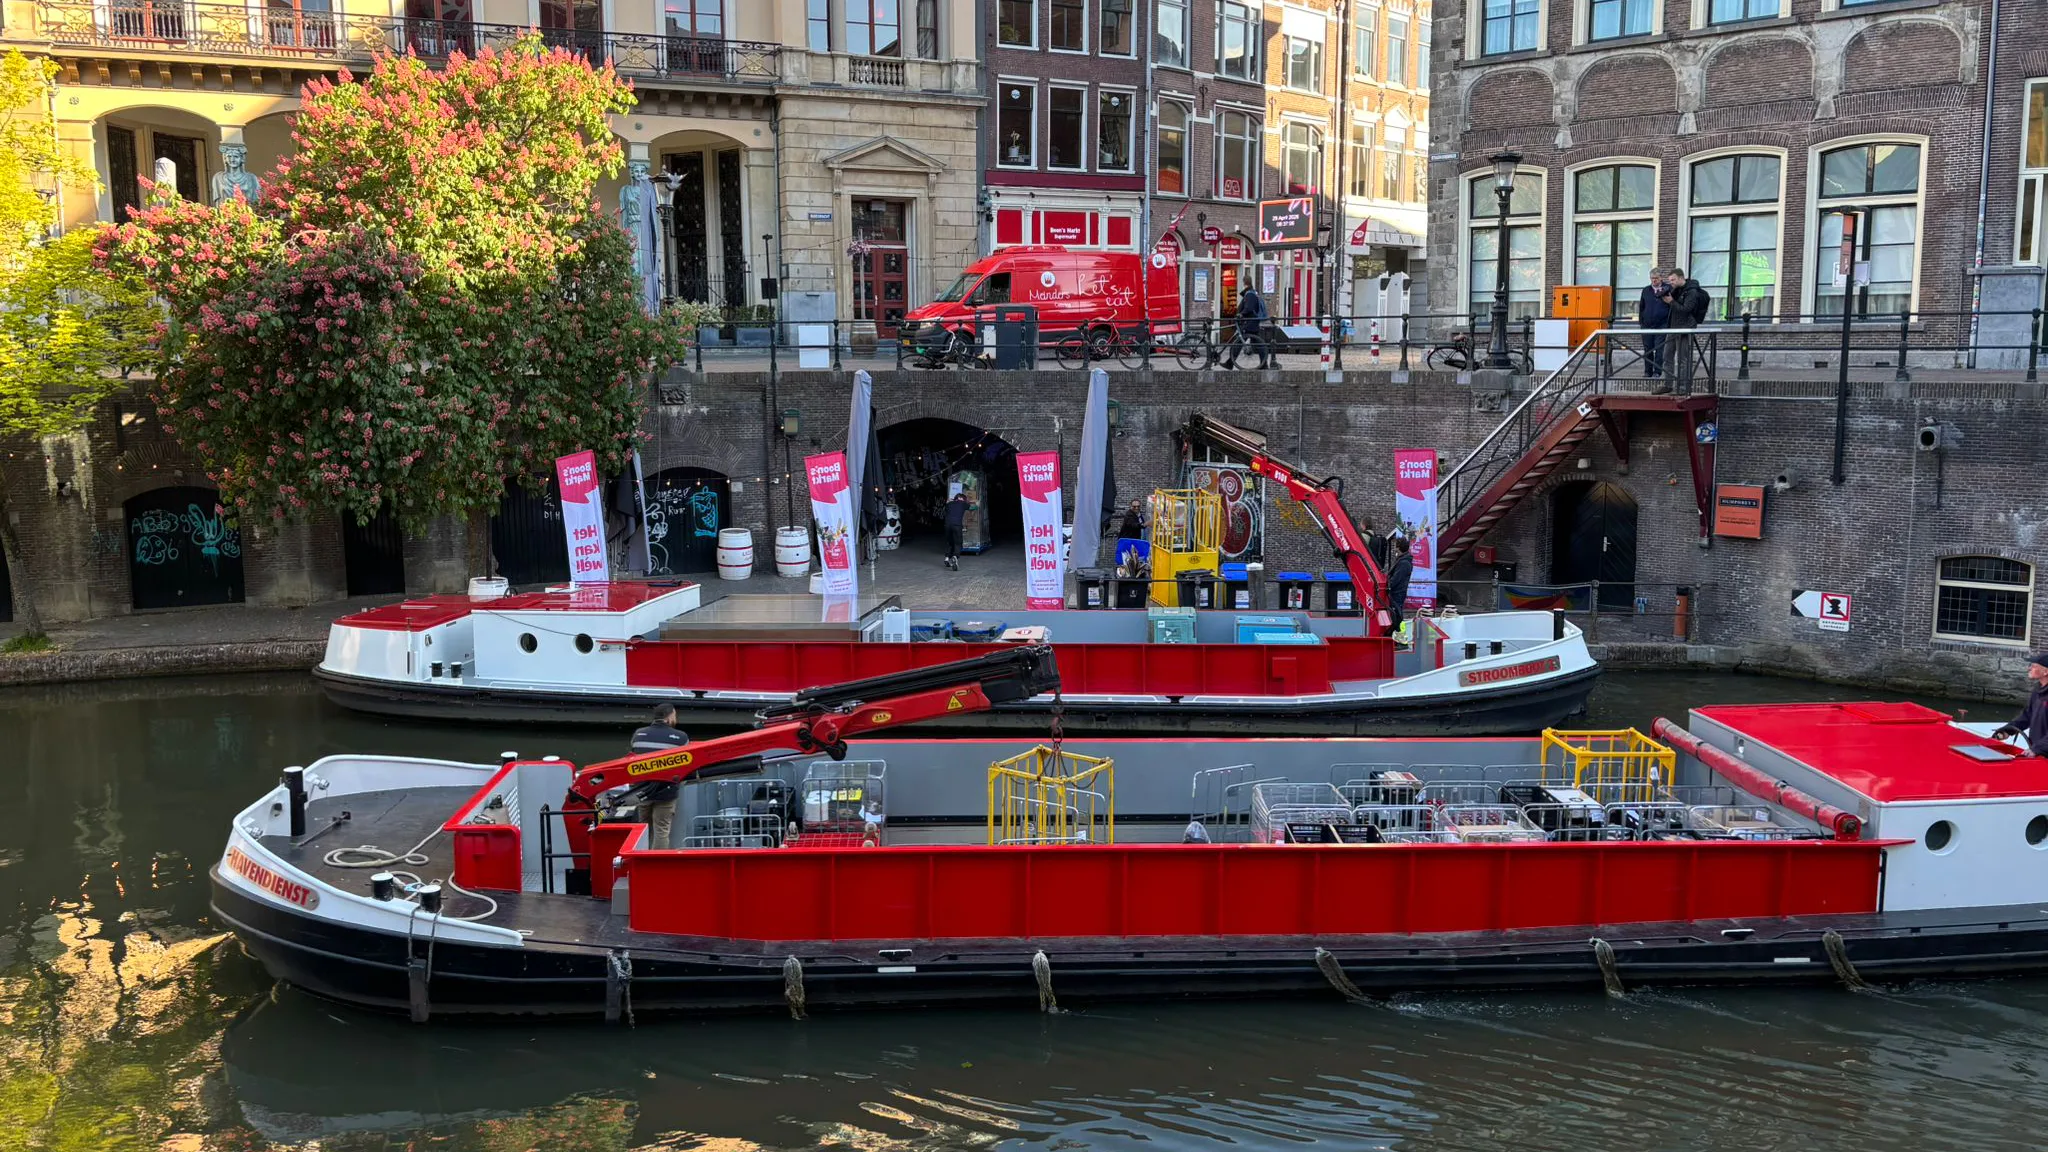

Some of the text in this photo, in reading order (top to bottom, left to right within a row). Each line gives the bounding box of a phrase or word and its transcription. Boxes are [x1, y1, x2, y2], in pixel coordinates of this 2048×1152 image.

[1078, 273, 1121, 296] Let's
[1106, 287, 1134, 306] eat
[631, 753, 690, 774] PALFINGER
[229, 848, 311, 906] HAVENDIENST
